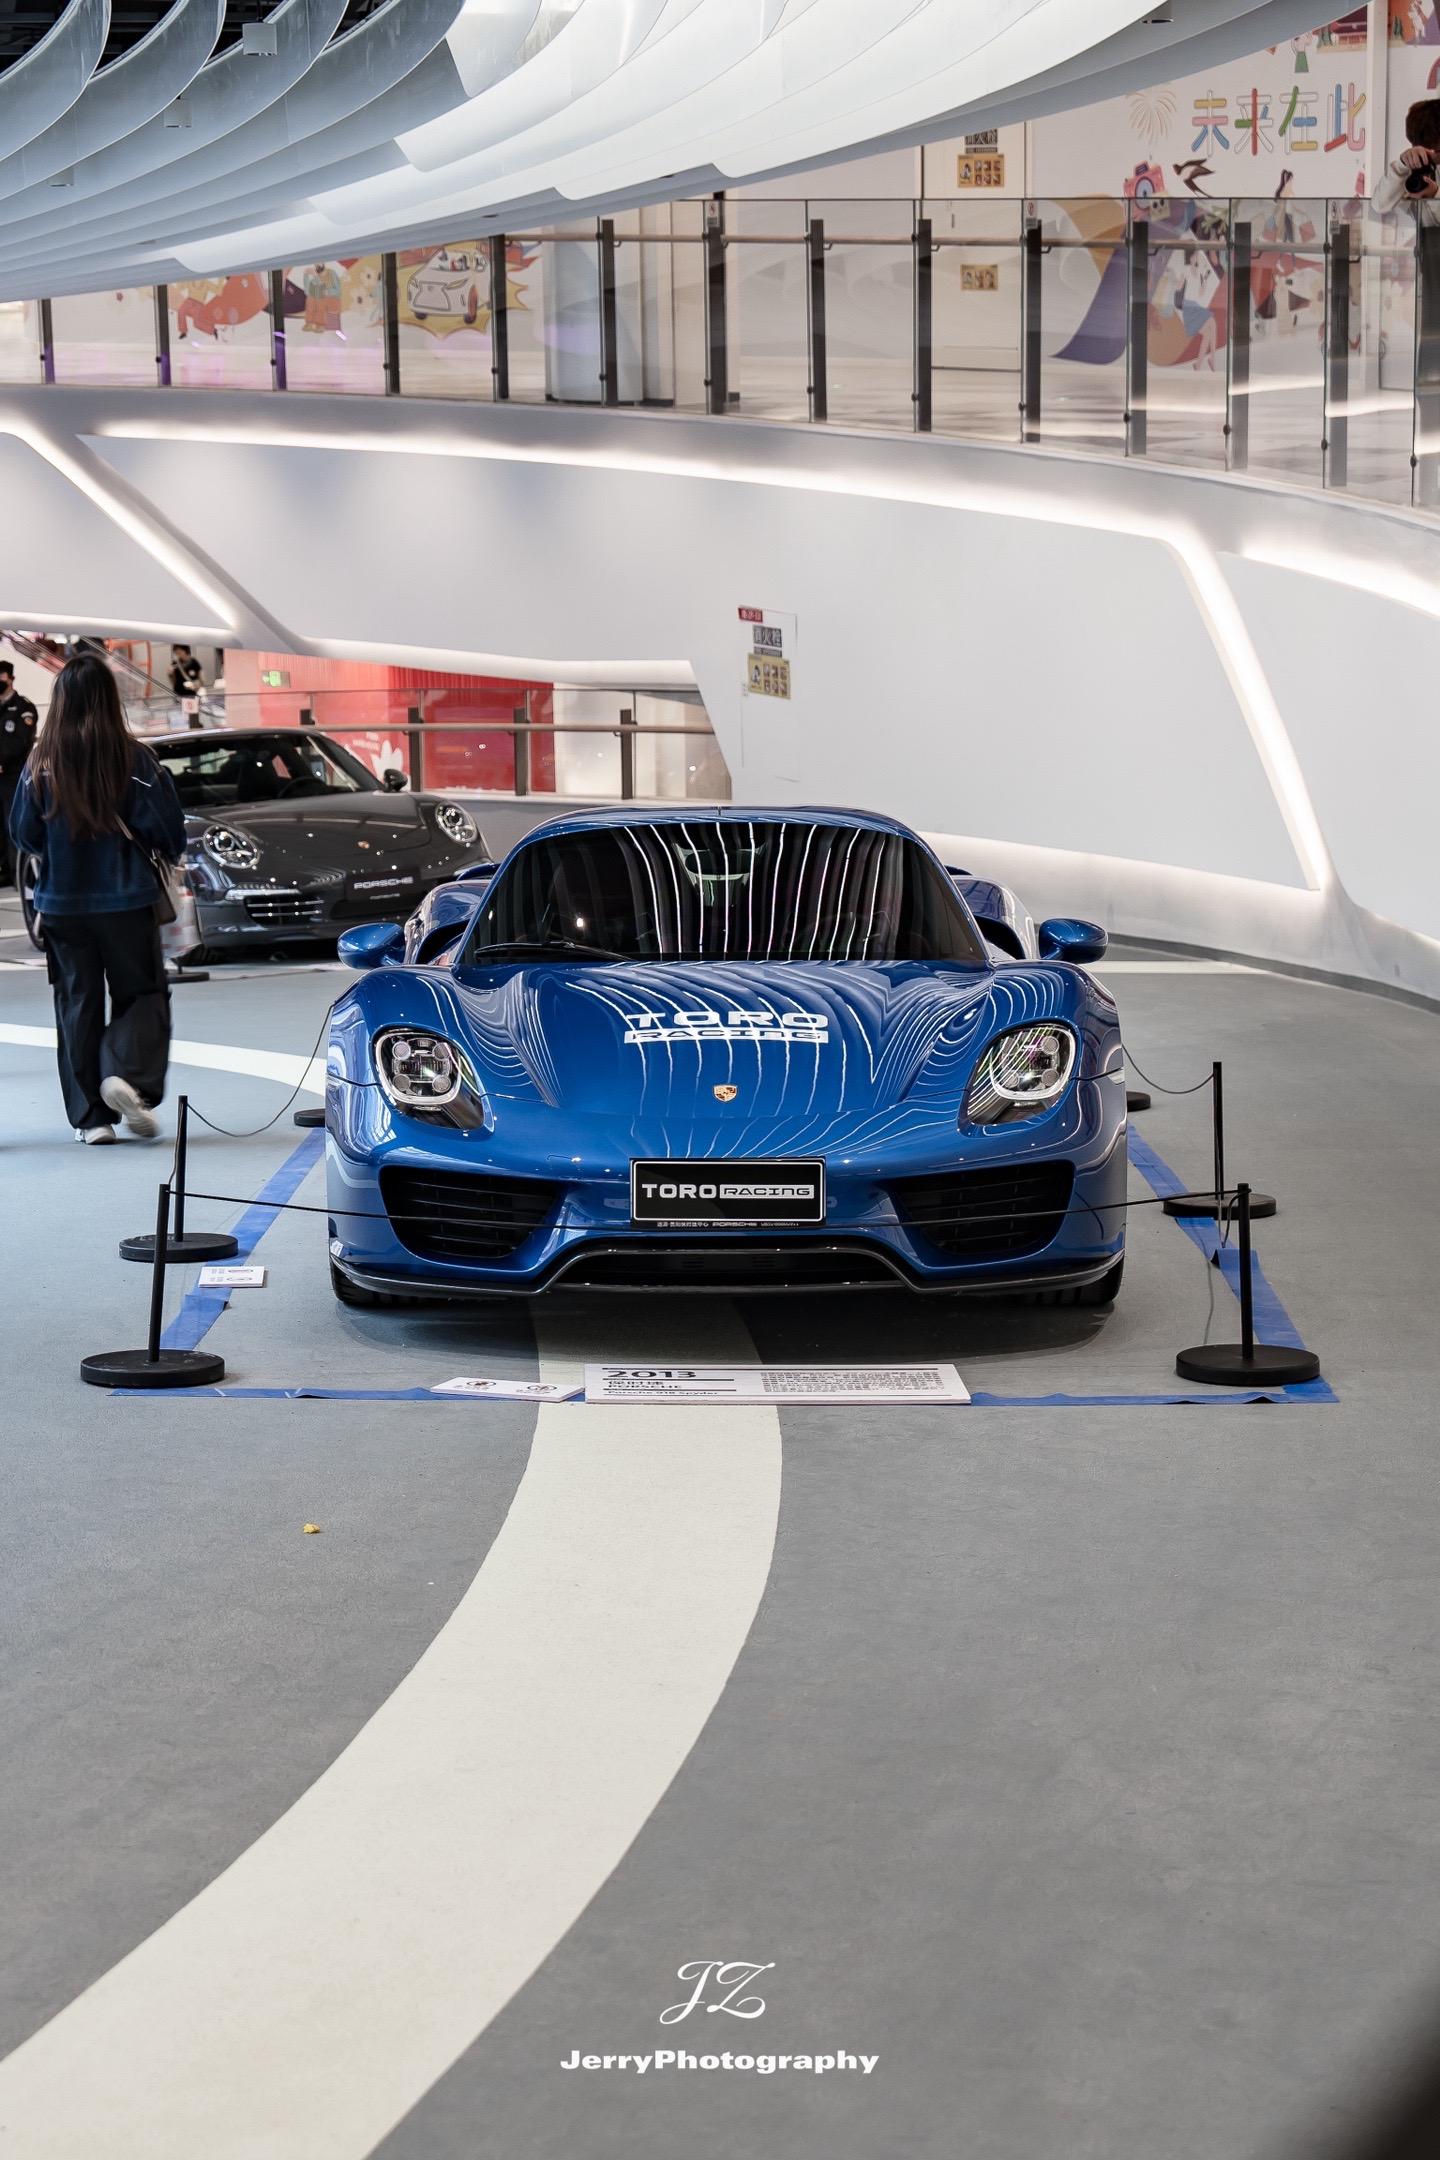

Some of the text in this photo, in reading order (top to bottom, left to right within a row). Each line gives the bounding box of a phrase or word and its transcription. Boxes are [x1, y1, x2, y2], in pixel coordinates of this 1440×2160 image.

[1191, 82, 1367, 157] 未来在此
[353, 876, 414, 889] PORSCHE
[625, 1011, 829, 1028] TORO
[630, 1029, 823, 1041] RACING
[642, 1184, 811, 1199] TORO RACING
